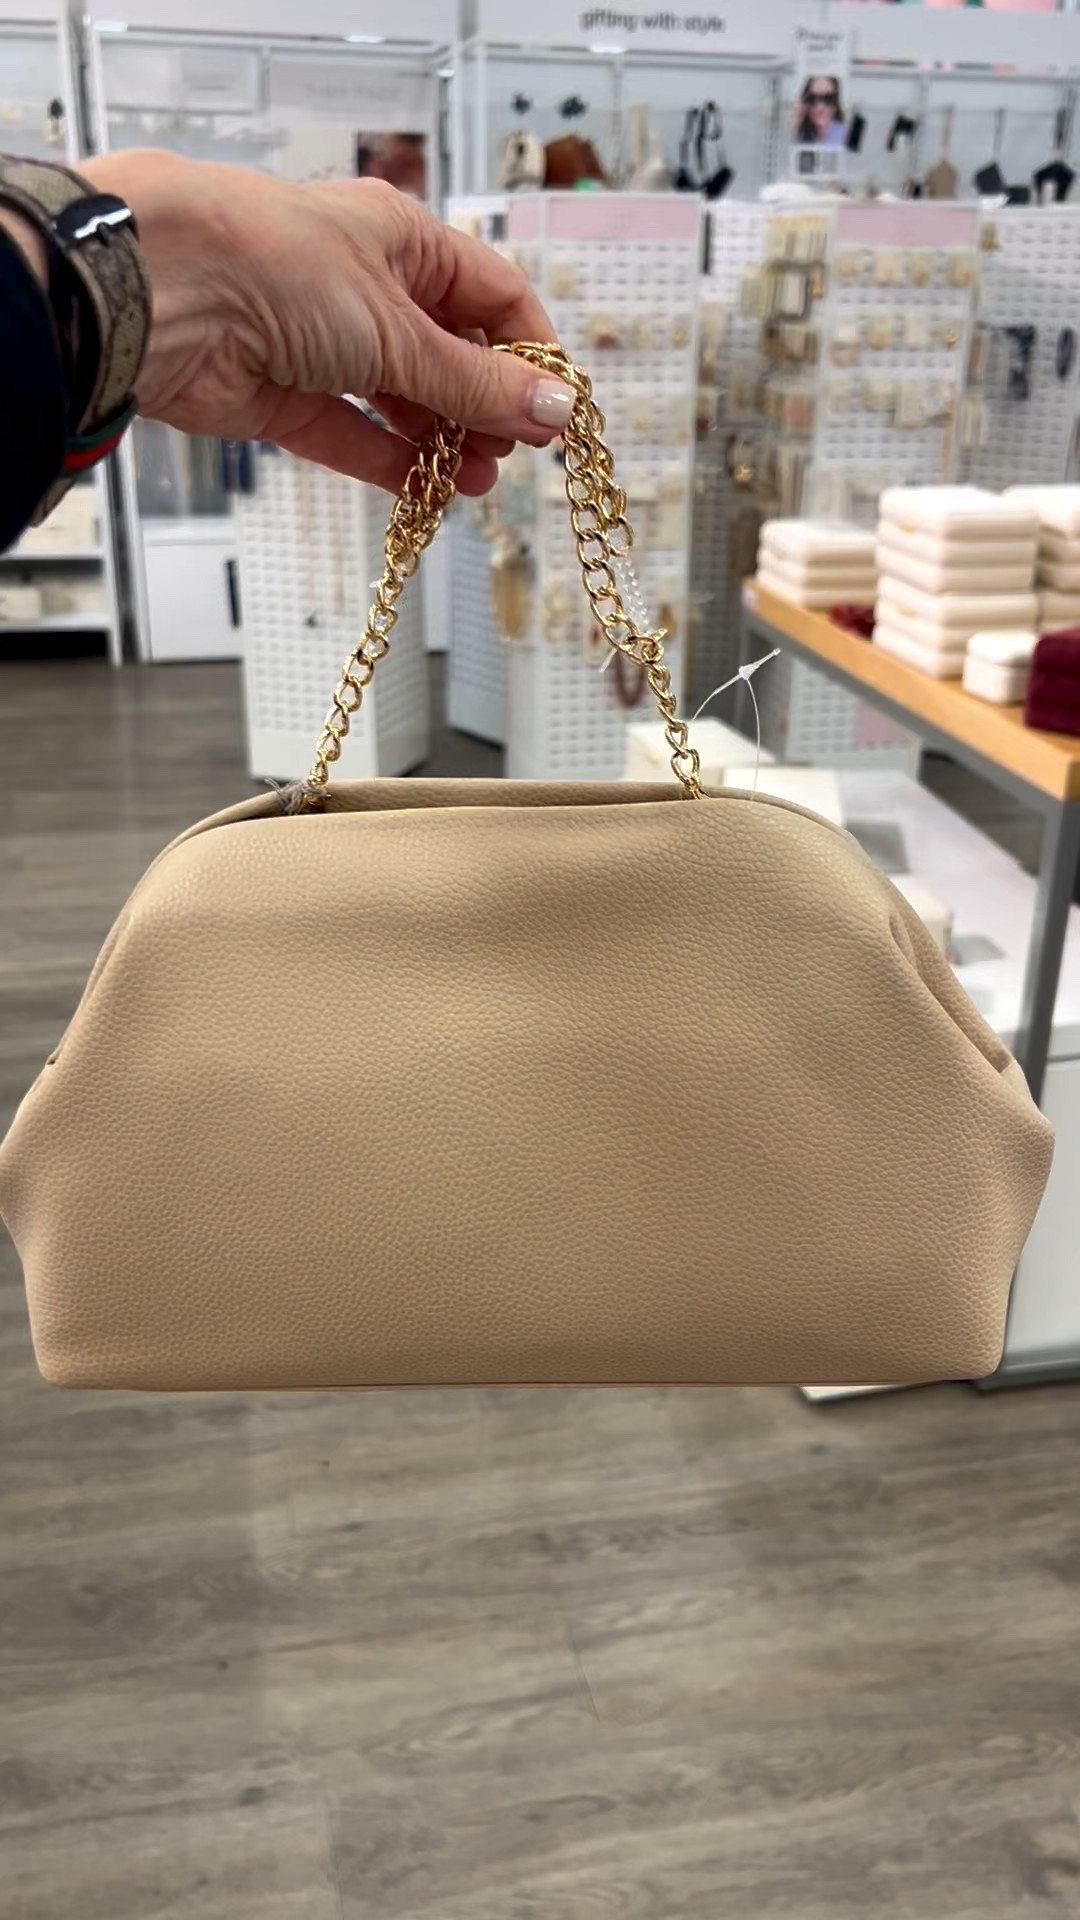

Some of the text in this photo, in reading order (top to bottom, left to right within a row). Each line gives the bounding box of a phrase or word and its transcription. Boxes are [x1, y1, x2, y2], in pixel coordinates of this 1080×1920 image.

[581, 9, 725, 36] gifting with style
